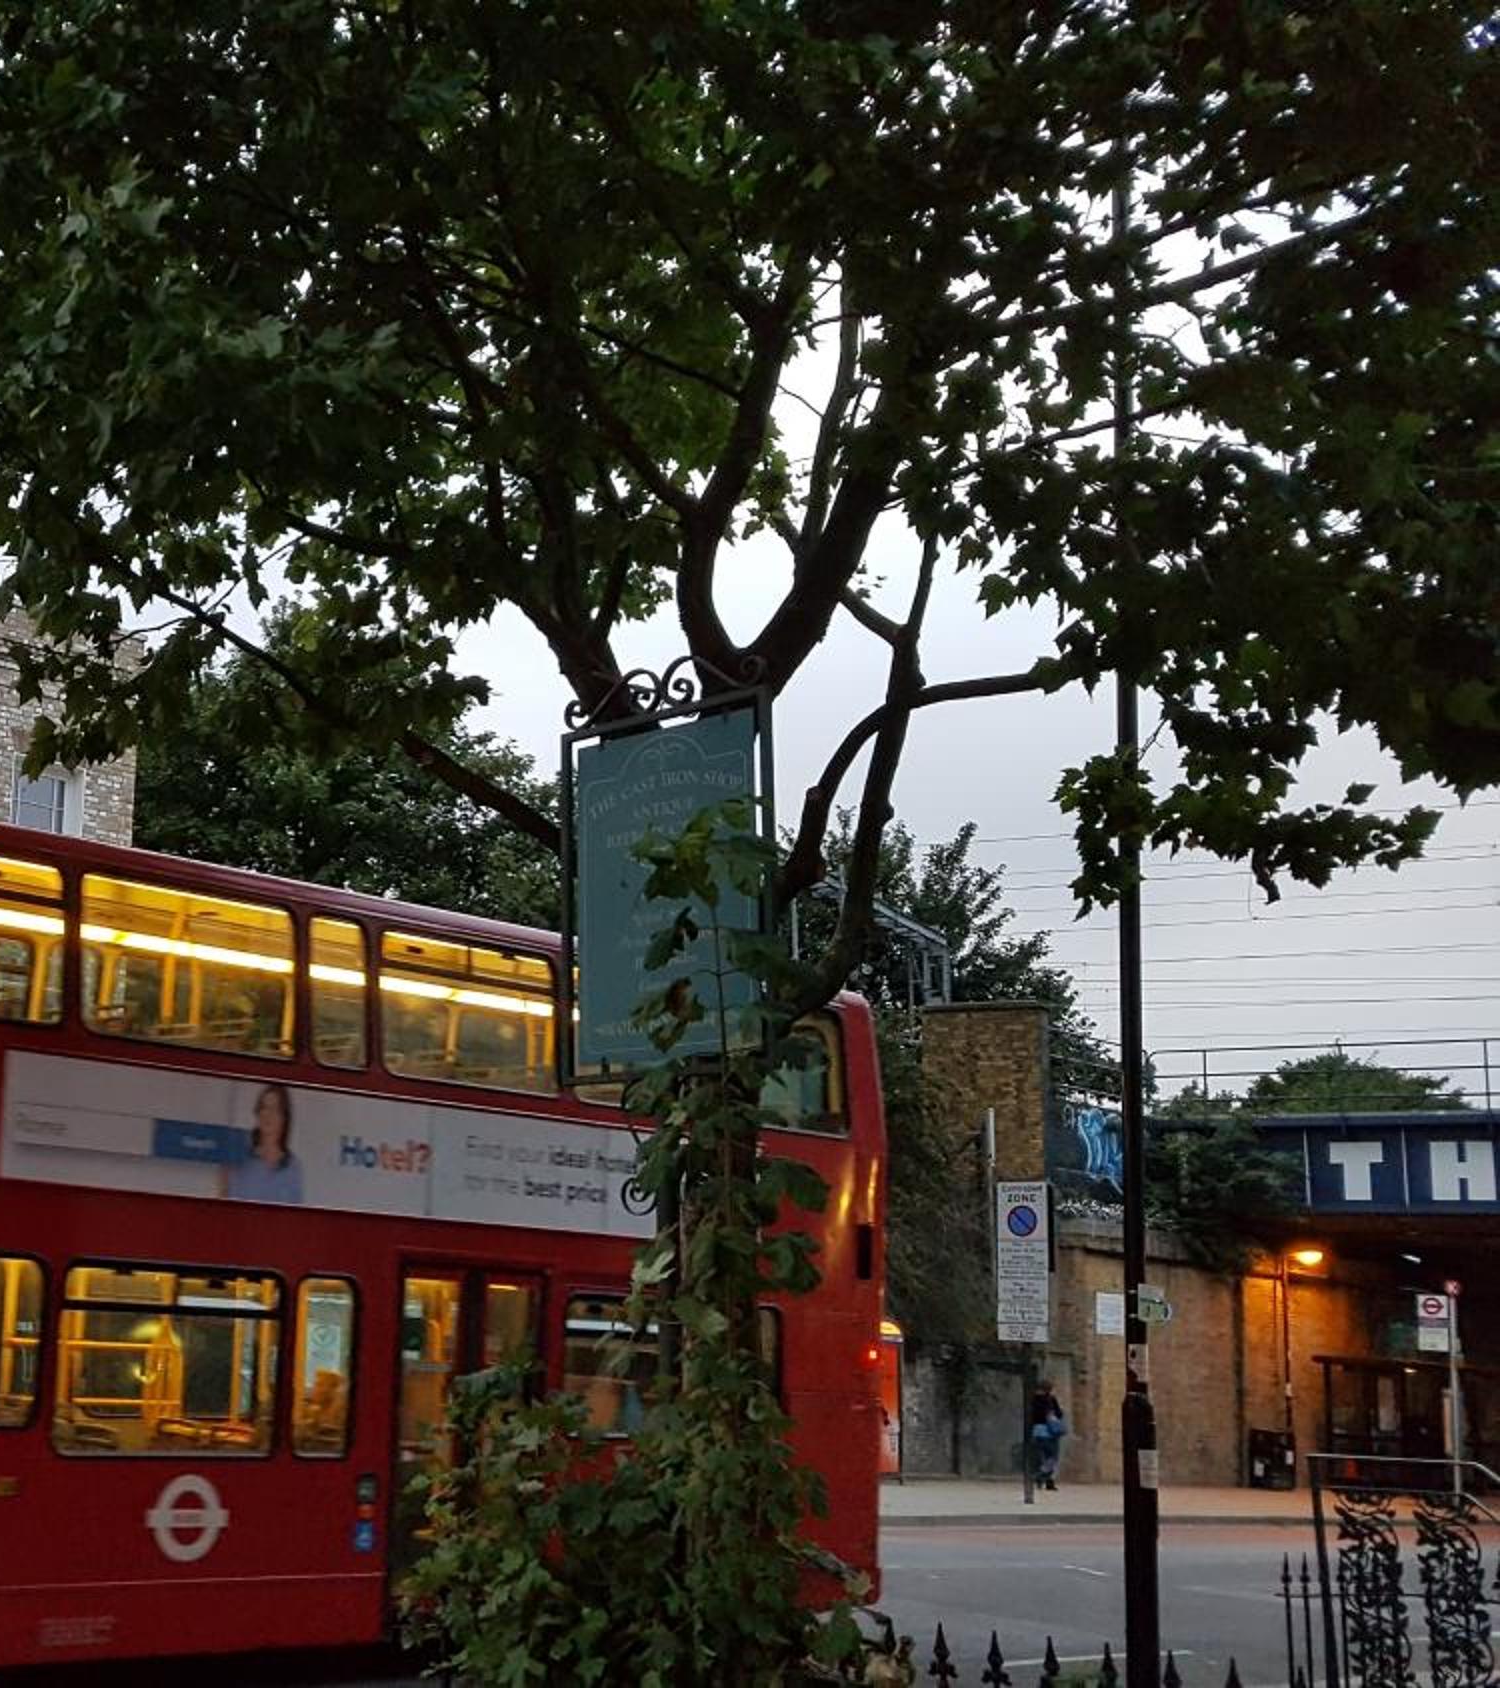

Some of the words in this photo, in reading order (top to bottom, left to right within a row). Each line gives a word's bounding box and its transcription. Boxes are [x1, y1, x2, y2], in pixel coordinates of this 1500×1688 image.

[660, 768, 699, 788] IRON
[339, 1134, 433, 1175] Hotel?
[548, 1144, 590, 1169] ideal
[524, 1176, 562, 1199] best
[1007, 1193, 1037, 1203] ZONE
